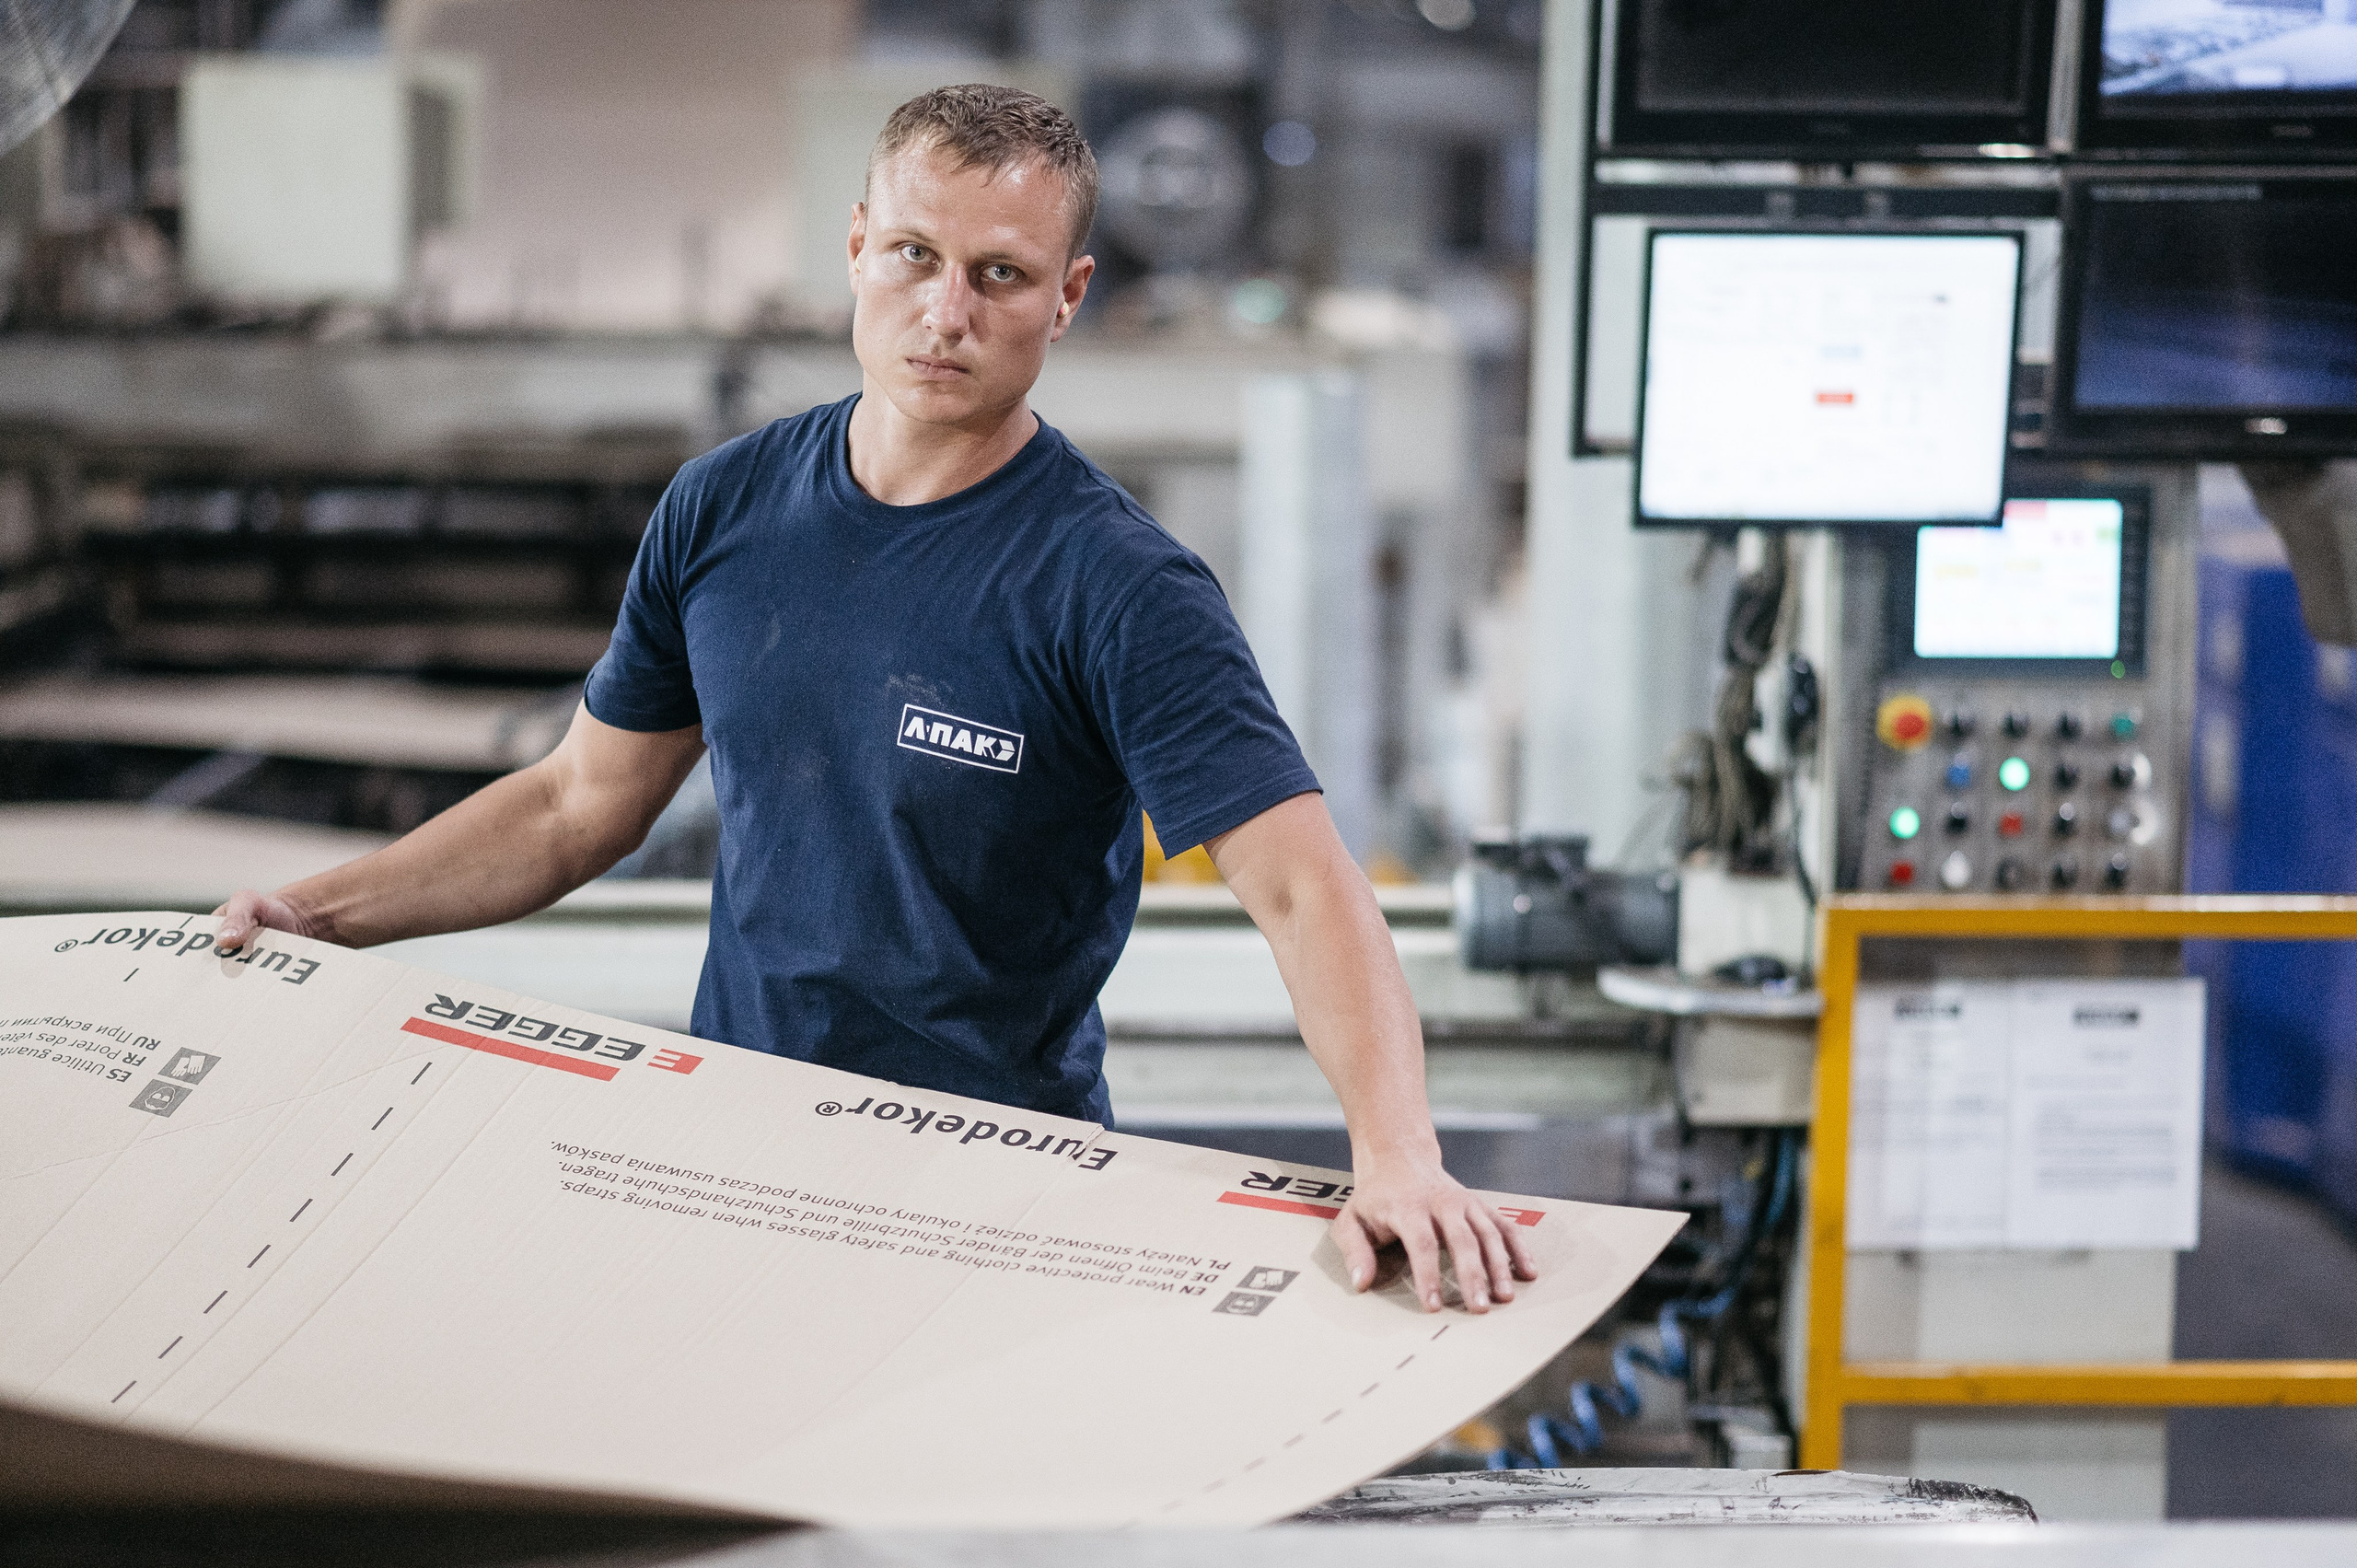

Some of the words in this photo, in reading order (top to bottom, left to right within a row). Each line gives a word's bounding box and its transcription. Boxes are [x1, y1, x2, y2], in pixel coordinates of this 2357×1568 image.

[11, 1016, 94, 1031] вскрытии
[424, 993, 646, 1062] EGGER
[0, 1031, 33, 1043] vête
[36, 1032, 68, 1047] des
[96, 1026, 134, 1043] При
[132, 1036, 162, 1051] RU
[67, 1039, 122, 1061] Porter
[122, 1051, 146, 1067] FR
[52, 1053, 106, 1075] Utilice
[106, 1068, 133, 1083] ES
[550, 1141, 626, 1165] pasków.
[557, 1161, 619, 1184] tragen.
[626, 1158, 715, 1184] usuwania
[559, 1180, 620, 1201] straps.
[621, 1176, 799, 1219] Schutzhandschuhe
[717, 1177, 798, 1200] podczas
[621, 1191, 709, 1218] removing
[798, 1193, 888, 1217] ochronne
[712, 1212, 762, 1228] when
[799, 1211, 839, 1225] und
[889, 1208, 961, 1229] okulary
[766, 1222, 840, 1241] glasses
[842, 1218, 956, 1246] Schutzbrille
[962, 1223, 973, 1234] i
[975, 1224, 1039, 1243] odzież
[839, 1233, 899, 1251] safety
[900, 1245, 940, 1258] and
[956, 1237, 1028, 1258] Bänder
[1039, 1236, 1132, 1256] stosować
[941, 1250, 1021, 1272] clothing
[1028, 1250, 1063, 1262] der
[1068, 1255, 1132, 1273] Öffnen
[1135, 1248, 1202, 1267] Należy
[1208, 1259, 1232, 1271] PL
[1025, 1264, 1125, 1284] protective
[1138, 1264, 1189, 1280] Beim
[1190, 1272, 1220, 1283] DE
[1123, 1278, 1175, 1293] Wear
[1178, 1284, 1208, 1295] EN
